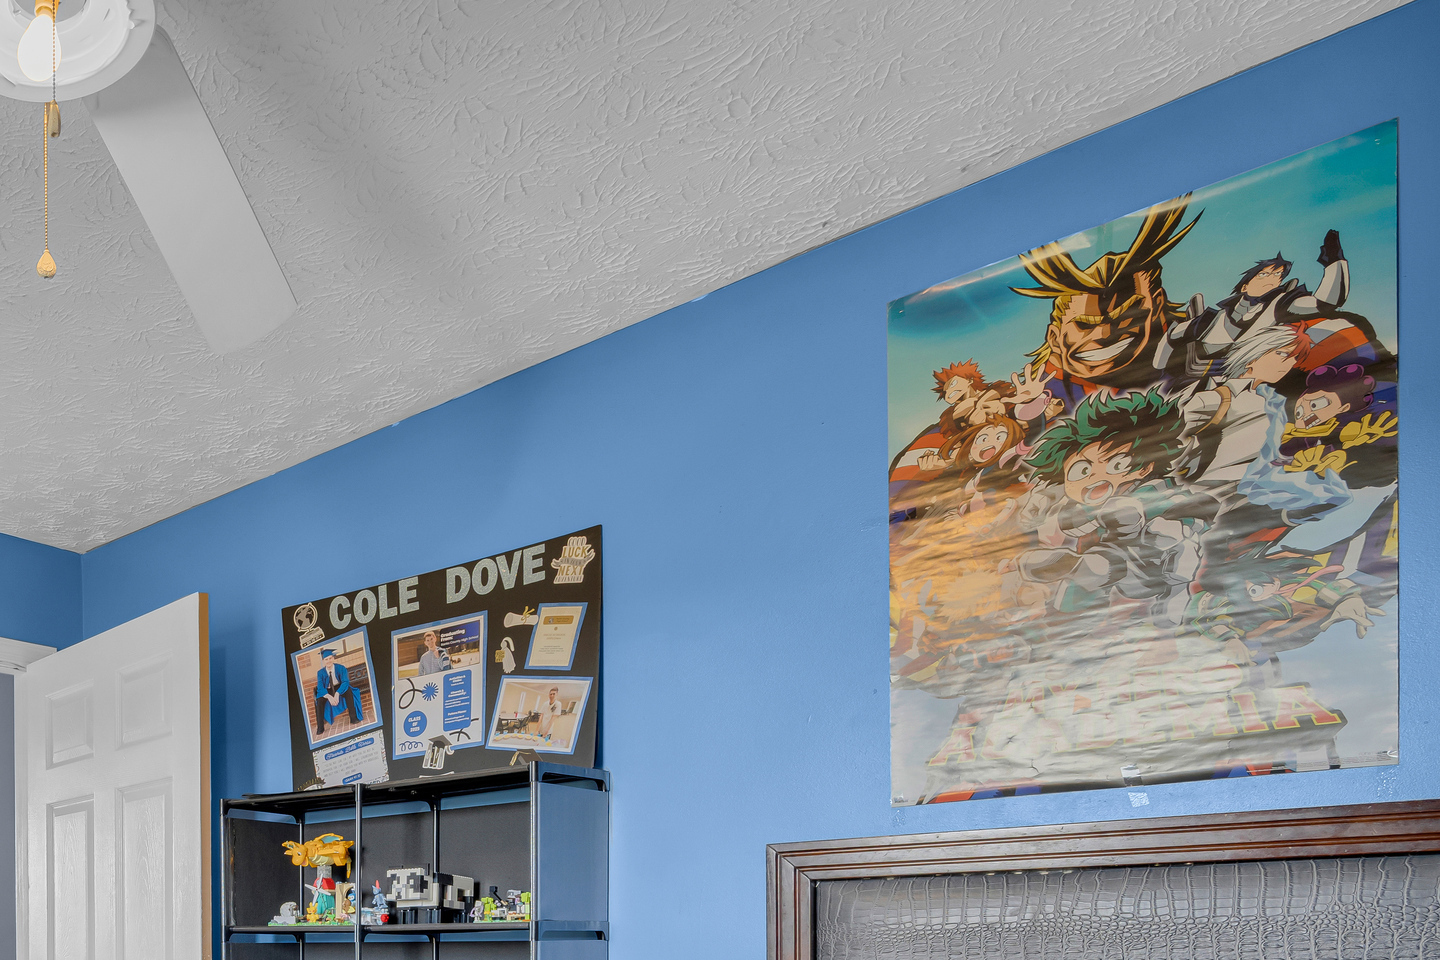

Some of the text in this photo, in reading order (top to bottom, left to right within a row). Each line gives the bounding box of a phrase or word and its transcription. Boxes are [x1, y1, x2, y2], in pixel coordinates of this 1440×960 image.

[558, 565, 584, 576] NEXT
[562, 546, 589, 558] LUCK
[329, 543, 546, 630] COLE DOVE
[1002, 663, 1242, 714] MY HERO
[928, 685, 1342, 766] ACADEMIA
